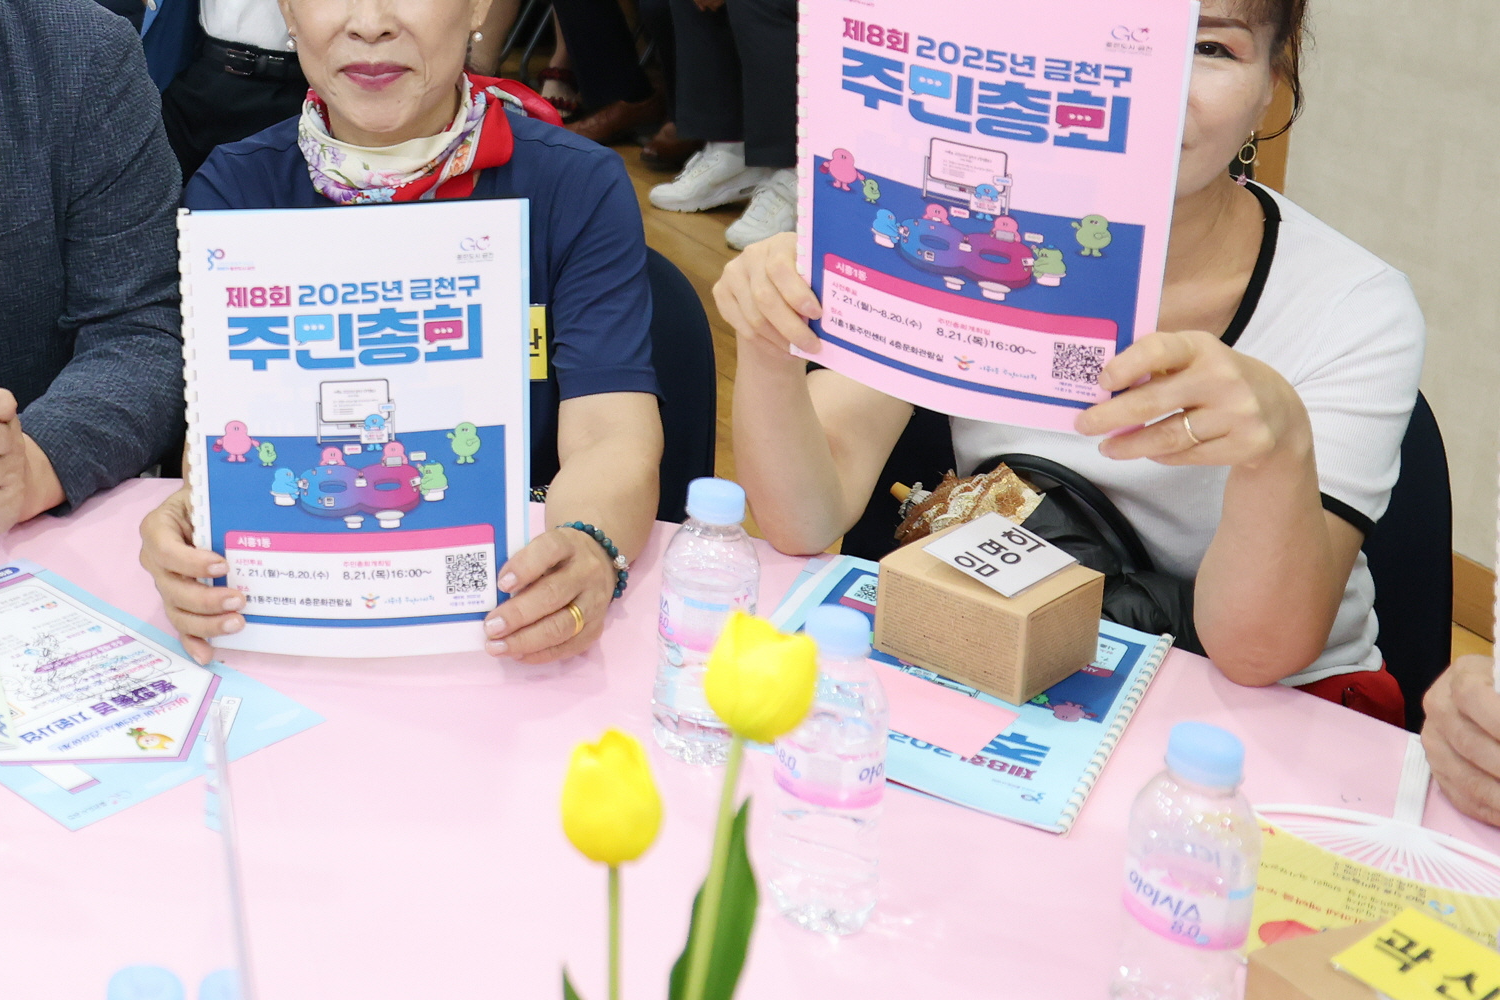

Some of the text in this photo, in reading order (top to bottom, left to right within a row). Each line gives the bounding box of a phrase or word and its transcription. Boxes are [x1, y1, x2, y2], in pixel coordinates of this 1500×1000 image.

[842, 17, 1134, 89] 제8회 2025년 금천구
[842, 46, 1132, 155] 주민총회
[836, 262, 868, 282] 시흥1동
[226, 275, 482, 309] 제8회 2025년 금천구
[226, 303, 484, 372] 주민총회
[237, 536, 272, 549] 시흥1동
[953, 528, 1047, 578] 임명희
[245, 594, 297, 606] 흥1동주민센터
[18, 711, 93, 745] 지원사업
